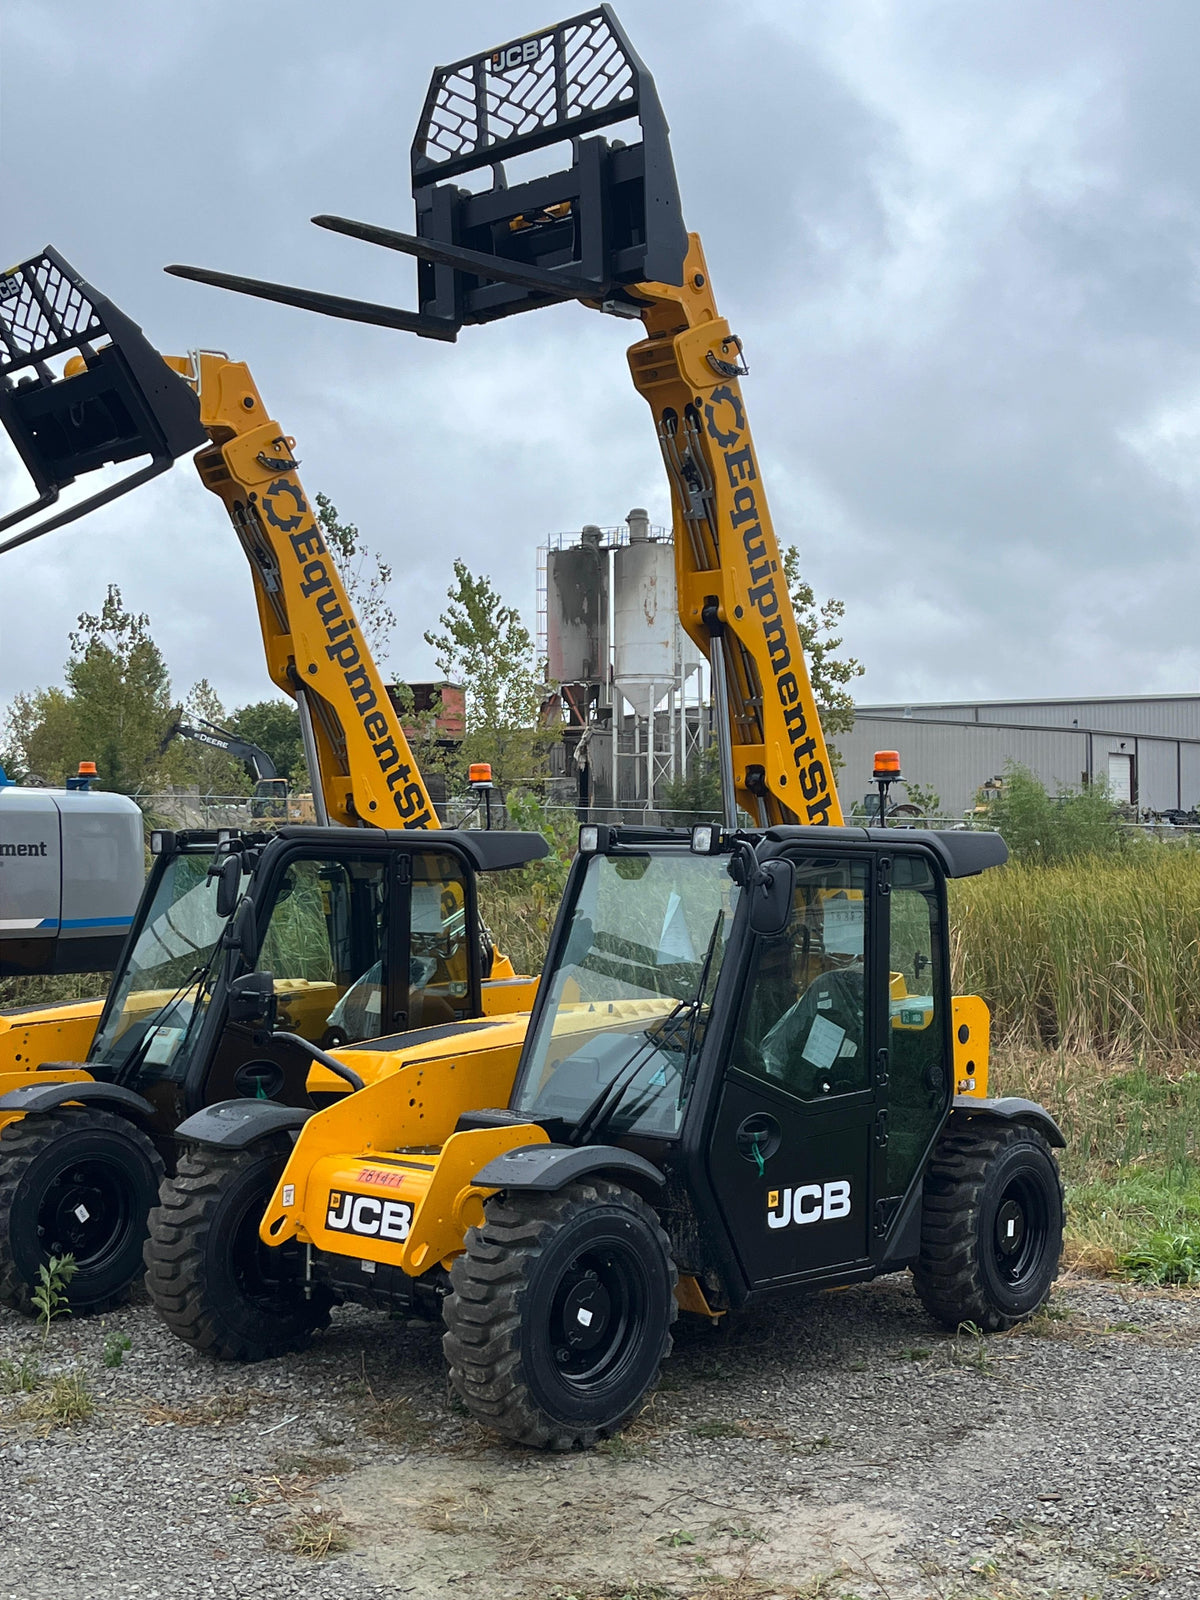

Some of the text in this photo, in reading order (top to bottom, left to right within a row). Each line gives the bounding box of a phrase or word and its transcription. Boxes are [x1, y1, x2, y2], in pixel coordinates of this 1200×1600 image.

[493, 40, 539, 72] JCB
[0, 277, 20, 299] CB
[200, 733, 229, 749] DEERE
[359, 1168, 405, 1187] 781471
[327, 1194, 412, 1240] JCB
[767, 1180, 851, 1229] JCB
